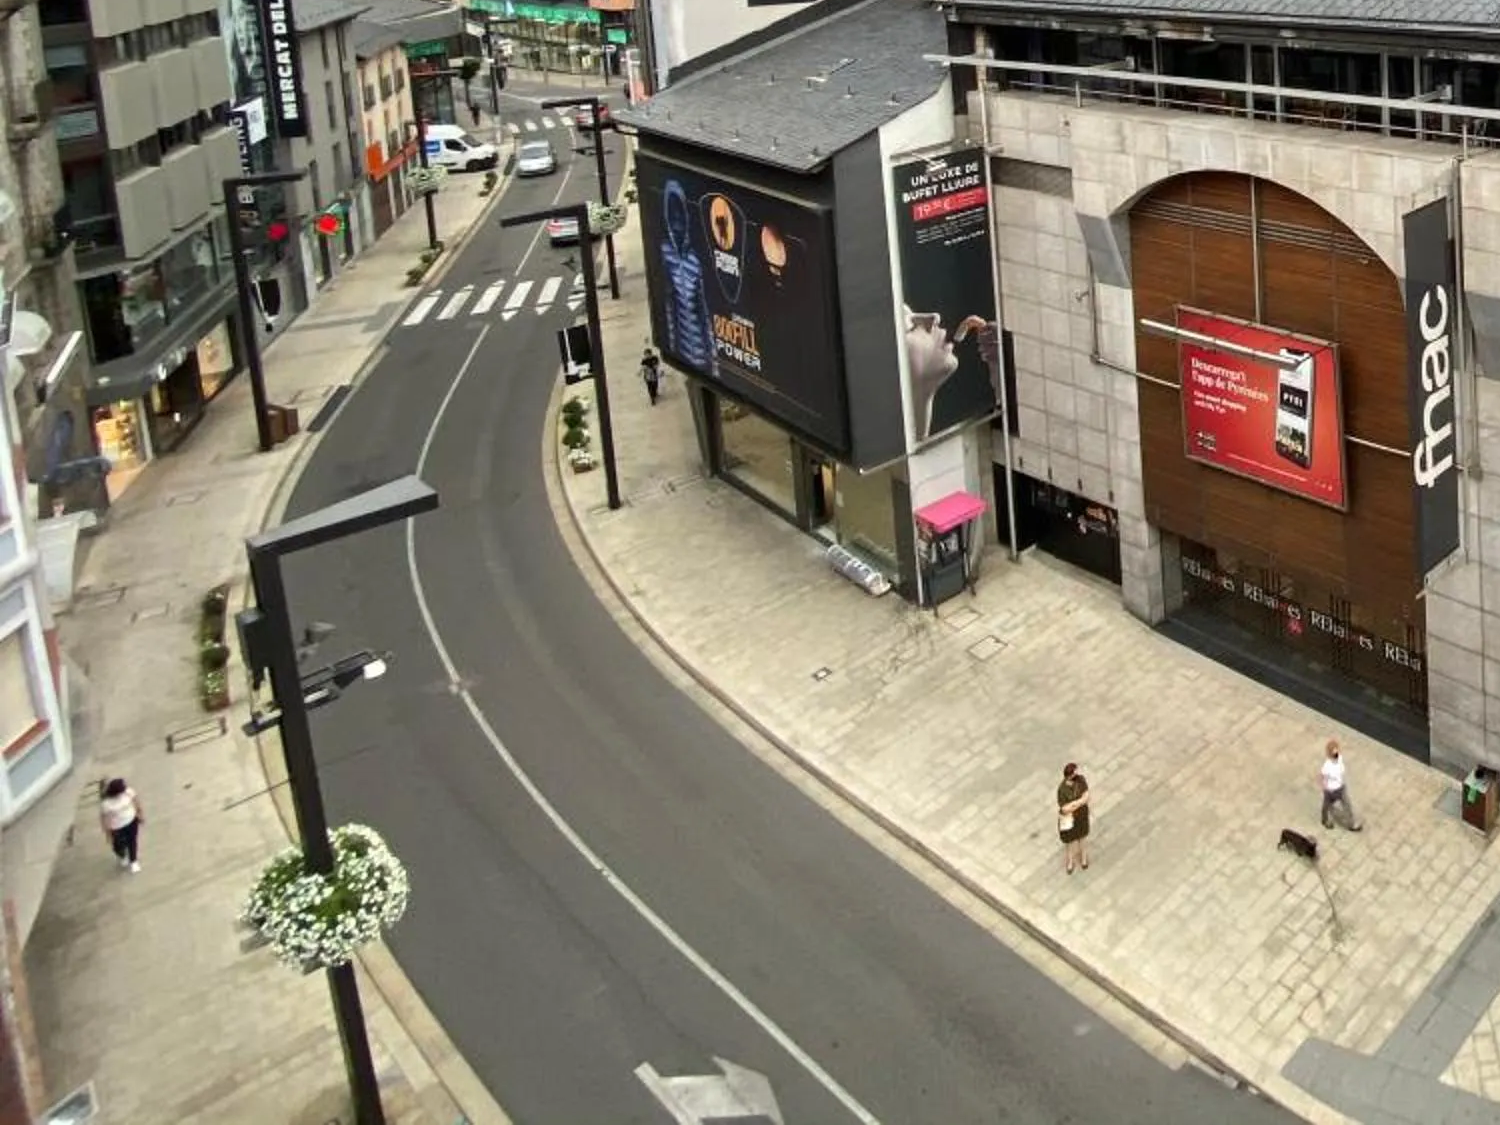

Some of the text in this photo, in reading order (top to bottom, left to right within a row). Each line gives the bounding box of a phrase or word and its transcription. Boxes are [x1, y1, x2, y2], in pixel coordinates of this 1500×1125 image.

[273, 39, 299, 120] MERCAT
[902, 184, 939, 203] BUFET
[911, 175, 929, 187] UN
[1414, 284, 1453, 489] fnac
